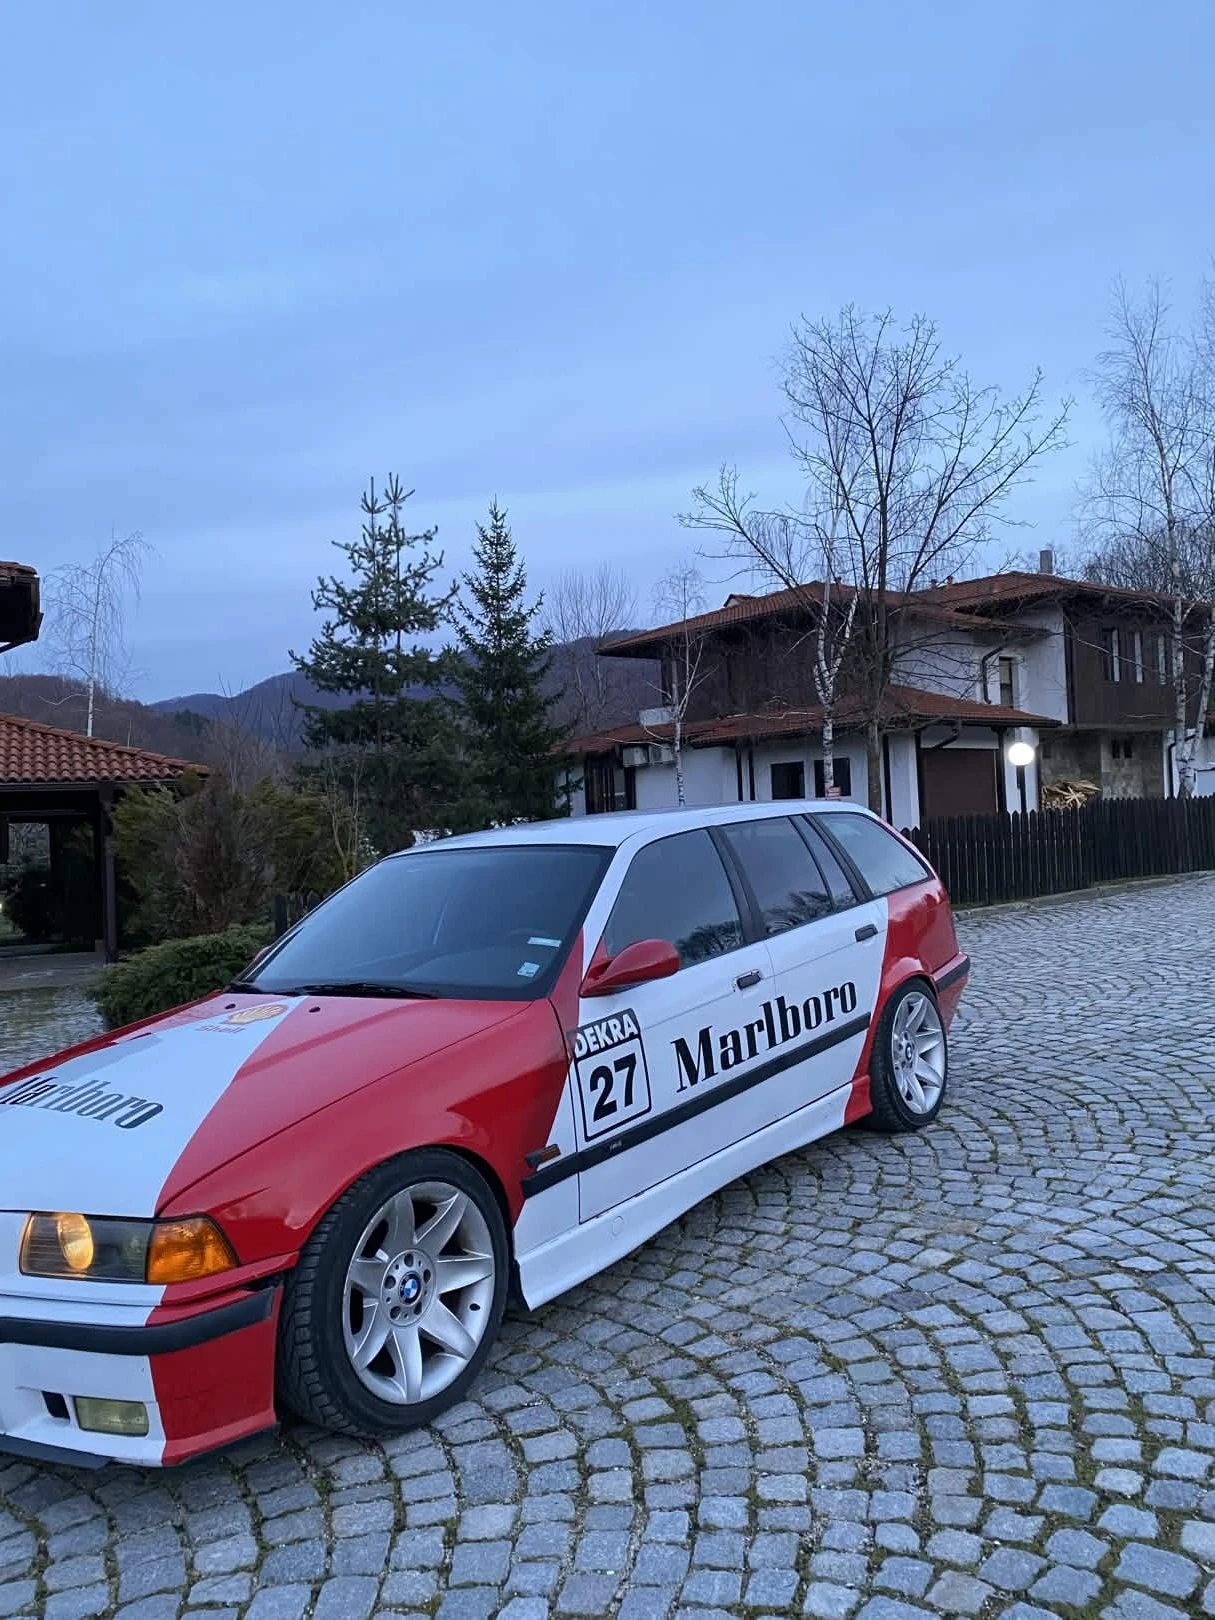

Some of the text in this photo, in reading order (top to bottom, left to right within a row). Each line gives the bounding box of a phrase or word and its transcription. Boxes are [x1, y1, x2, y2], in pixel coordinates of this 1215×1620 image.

[574, 1013, 639, 1059] DEKRA
[670, 981, 857, 1093] Marlboro
[589, 1052, 637, 1122] 27
